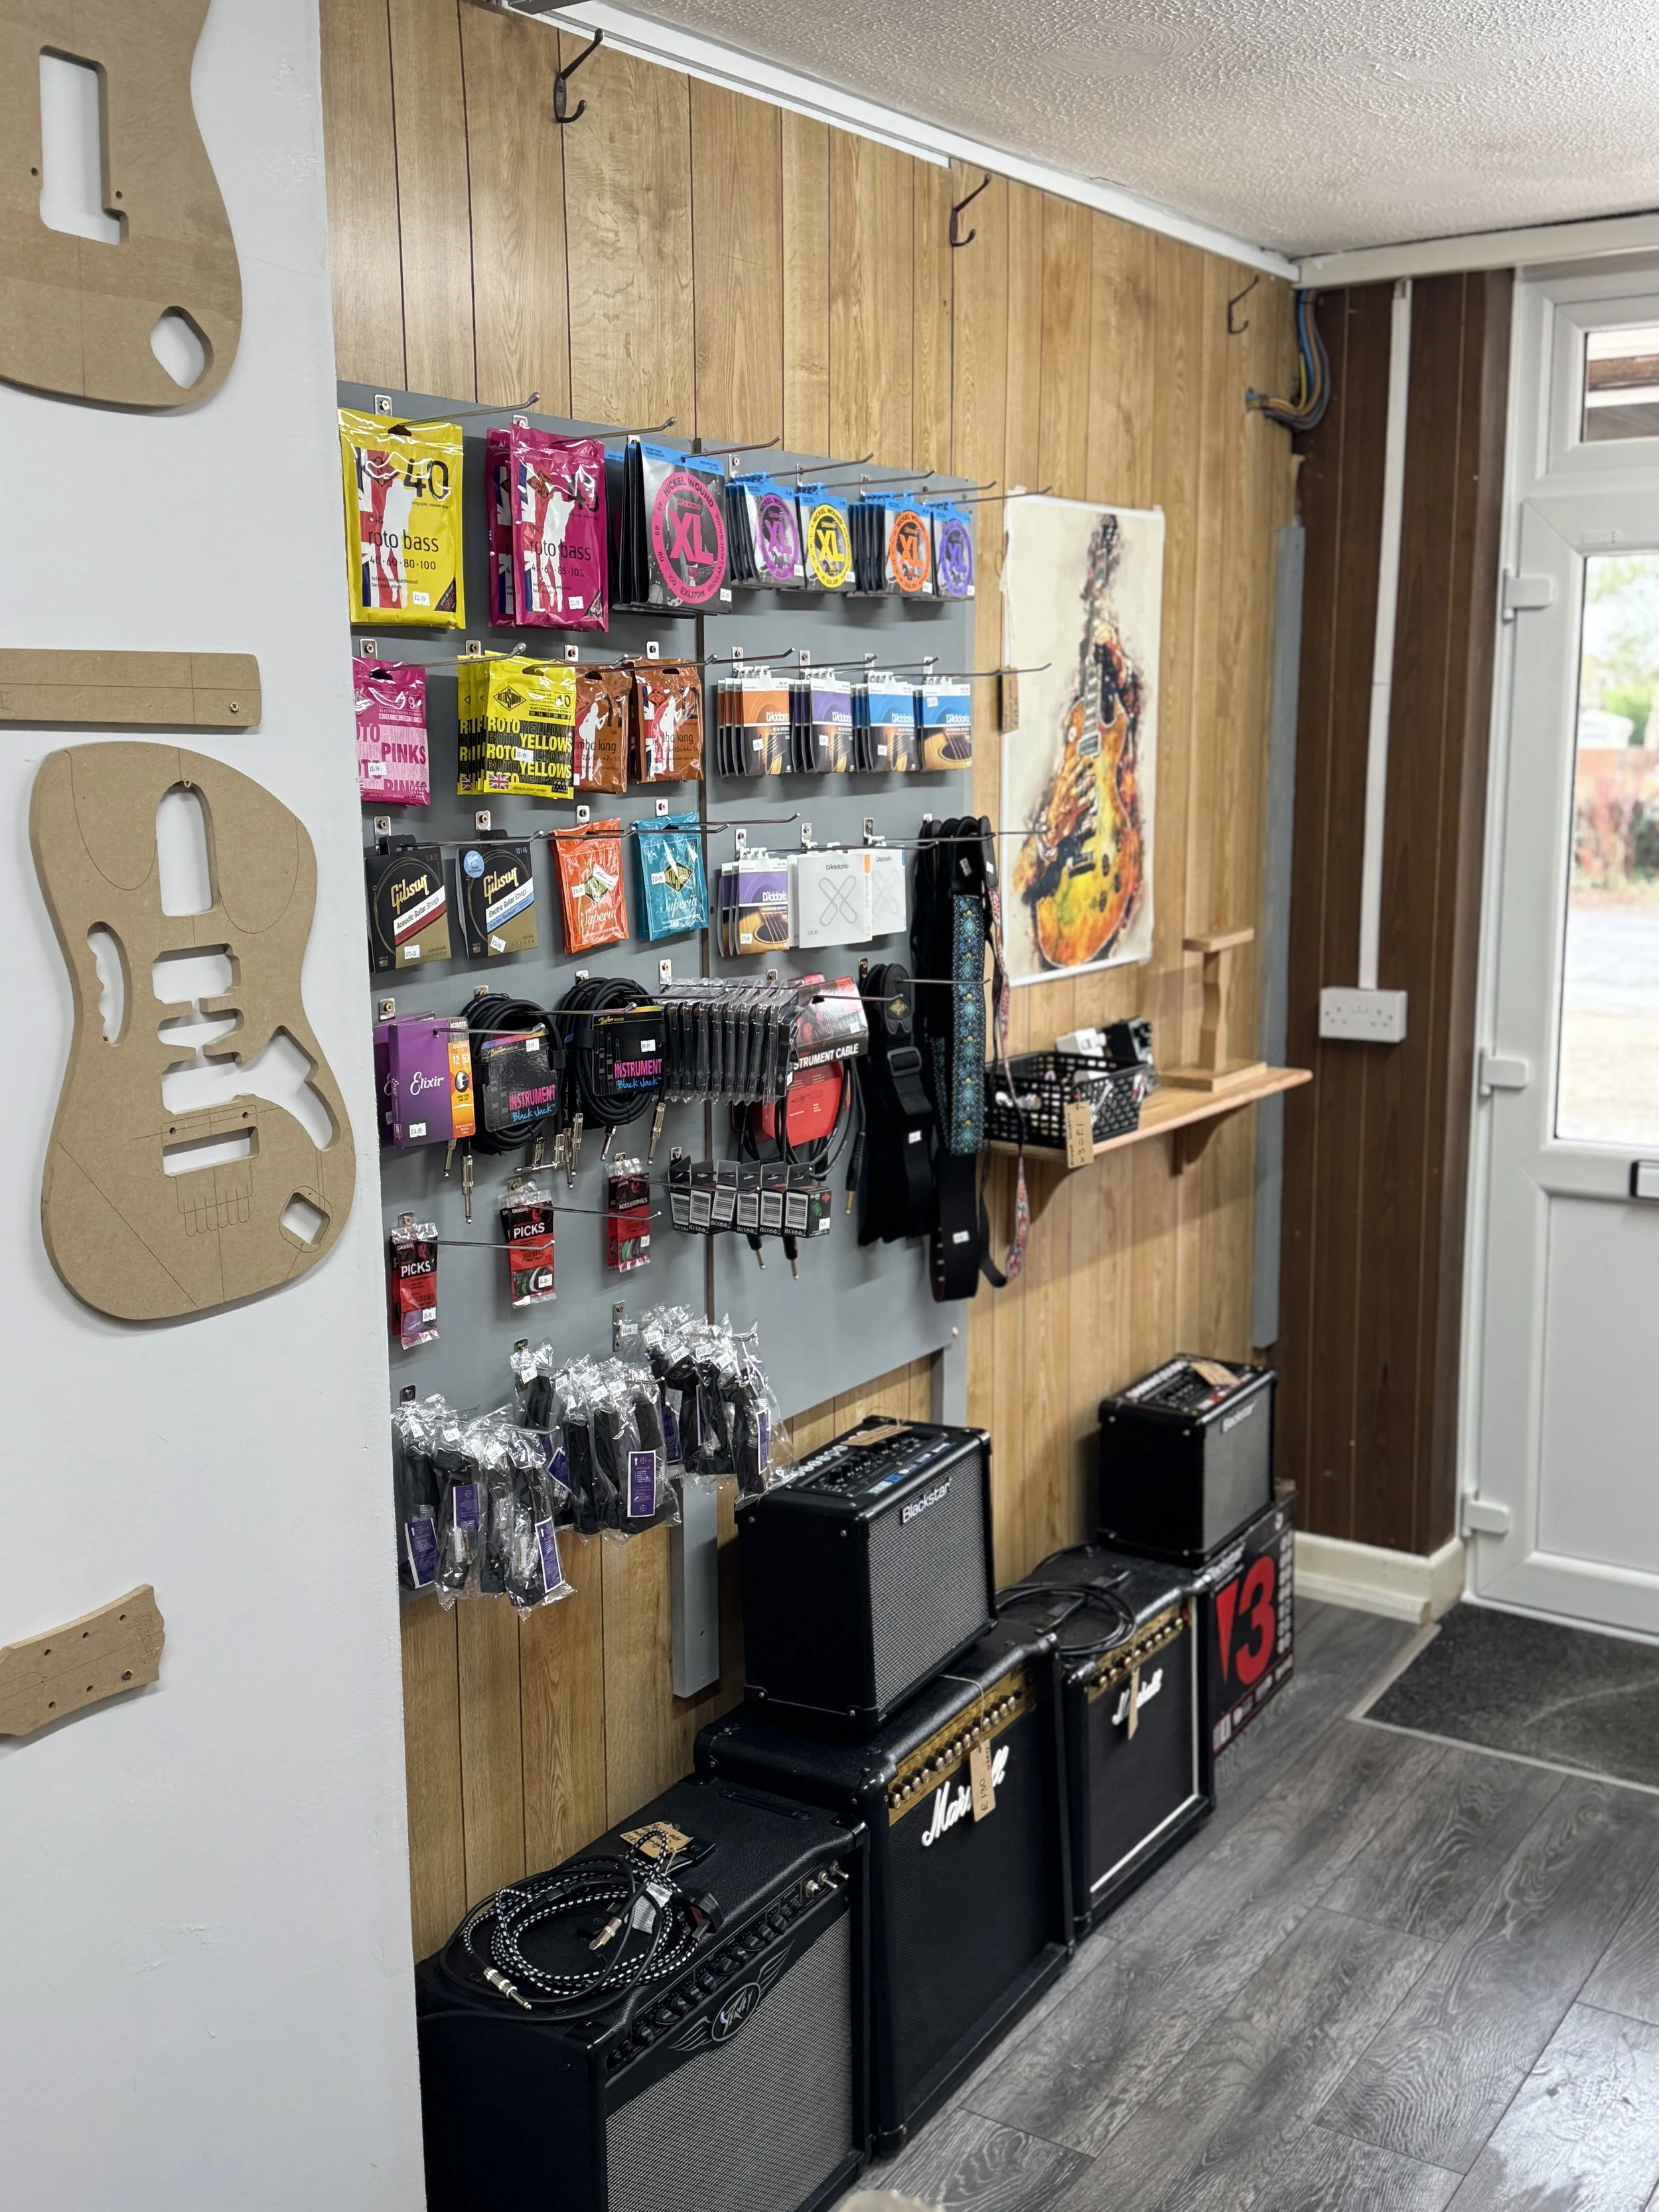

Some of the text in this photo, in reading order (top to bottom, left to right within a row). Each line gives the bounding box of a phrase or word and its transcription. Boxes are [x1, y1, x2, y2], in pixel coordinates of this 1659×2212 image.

[403, 458, 449, 501] 40
[664, 477, 686, 496] NICKEL
[687, 477, 714, 508] WOUND
[774, 496, 790, 516] WOUND
[813, 508, 843, 524] NICKEL WOUND
[368, 529, 439, 552] roto bass
[654, 525, 660, 536] 65
[668, 509, 713, 565] XL
[764, 519, 792, 554] XL
[530, 539, 591, 561] roto bass
[816, 529, 845, 562] XL
[899, 533, 924, 567] XL
[658, 551, 664, 562] 80
[948, 542, 968, 573] XL
[488, 717, 520, 734] ROTO
[520, 733, 573, 753] YELLOWS
[598, 739, 616, 754] king
[677, 730, 693, 744] king
[381, 742, 426, 765] PINKS
[520, 761, 572, 778] YELLOWS
[390, 874, 430, 915] Gibson
[483, 867, 519, 905] Gibson
[762, 891, 788, 902] D'Addario
[397, 897, 439, 930] Acoustic Guitar Strings
[488, 889, 527, 918] Electric Guitar Strings
[660, 894, 697, 917] Superia
[452, 1055, 460, 1066] 12
[835, 1043, 859, 1059] CABLE
[614, 1059, 662, 1079] INSTRUMENT
[409, 1071, 445, 1096] Elixir
[616, 1078, 638, 1090] Black
[508, 1084, 556, 1112] INSTRUMENT
[511, 1107, 533, 1122] Black
[618, 1197, 648, 1210] ACCESSORIES
[514, 1222, 545, 1239] PICKS
[401, 1260, 431, 1278] PICKS
[902, 1481, 951, 1524] Blackstar
